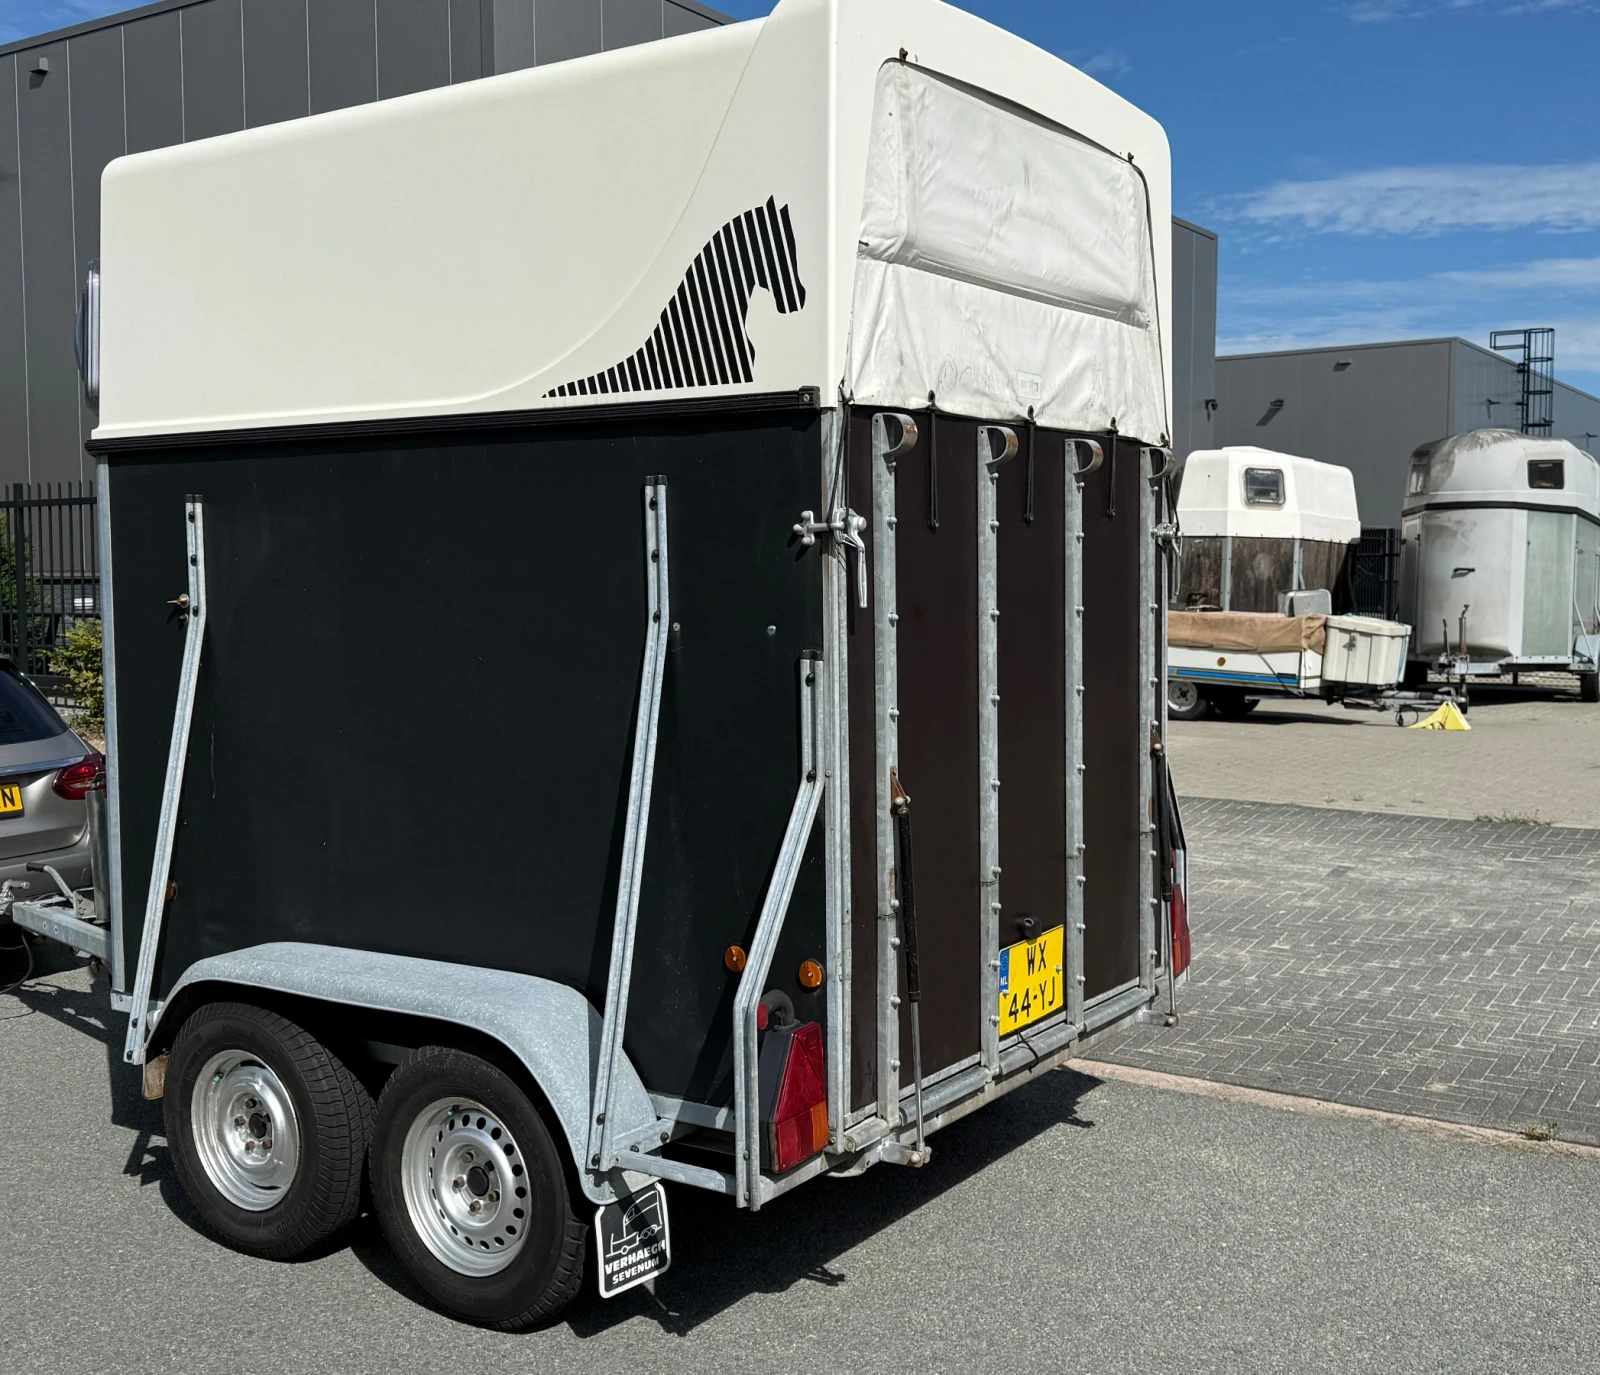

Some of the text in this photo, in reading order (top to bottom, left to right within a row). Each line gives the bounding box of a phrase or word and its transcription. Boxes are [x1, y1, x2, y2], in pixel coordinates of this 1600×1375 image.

[0, 786, 16, 809] N
[1026, 940, 1047, 977] WX
[1000, 975, 1008, 987] NL
[1008, 976, 1055, 1023] 44-YJ
[604, 1239, 666, 1275] VERHAEGH
[612, 1256, 660, 1285] SEVENUM
